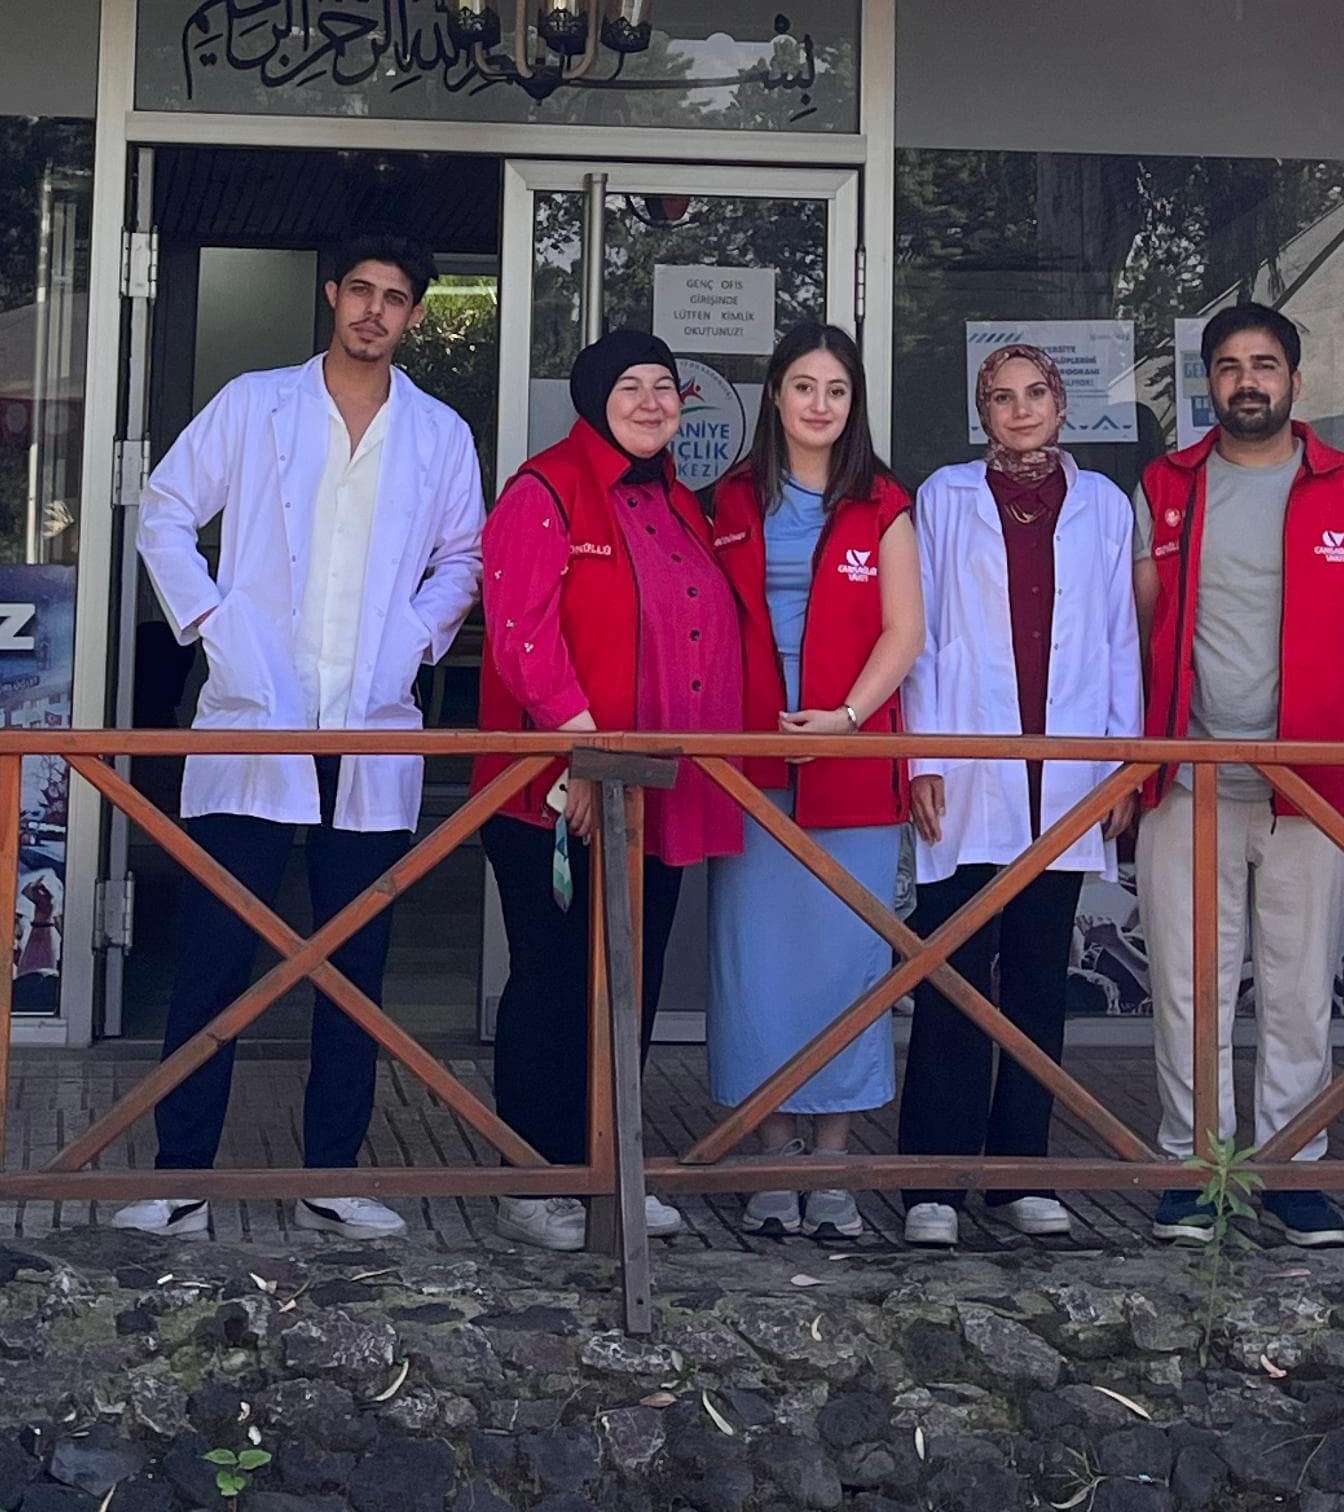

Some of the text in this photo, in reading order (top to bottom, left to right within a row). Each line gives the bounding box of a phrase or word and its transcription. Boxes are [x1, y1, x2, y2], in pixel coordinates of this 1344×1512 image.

[686, 279, 714, 291] GENÇ
[675, 420, 730, 439] ANİYE
[678, 461, 719, 477] KEZİ
